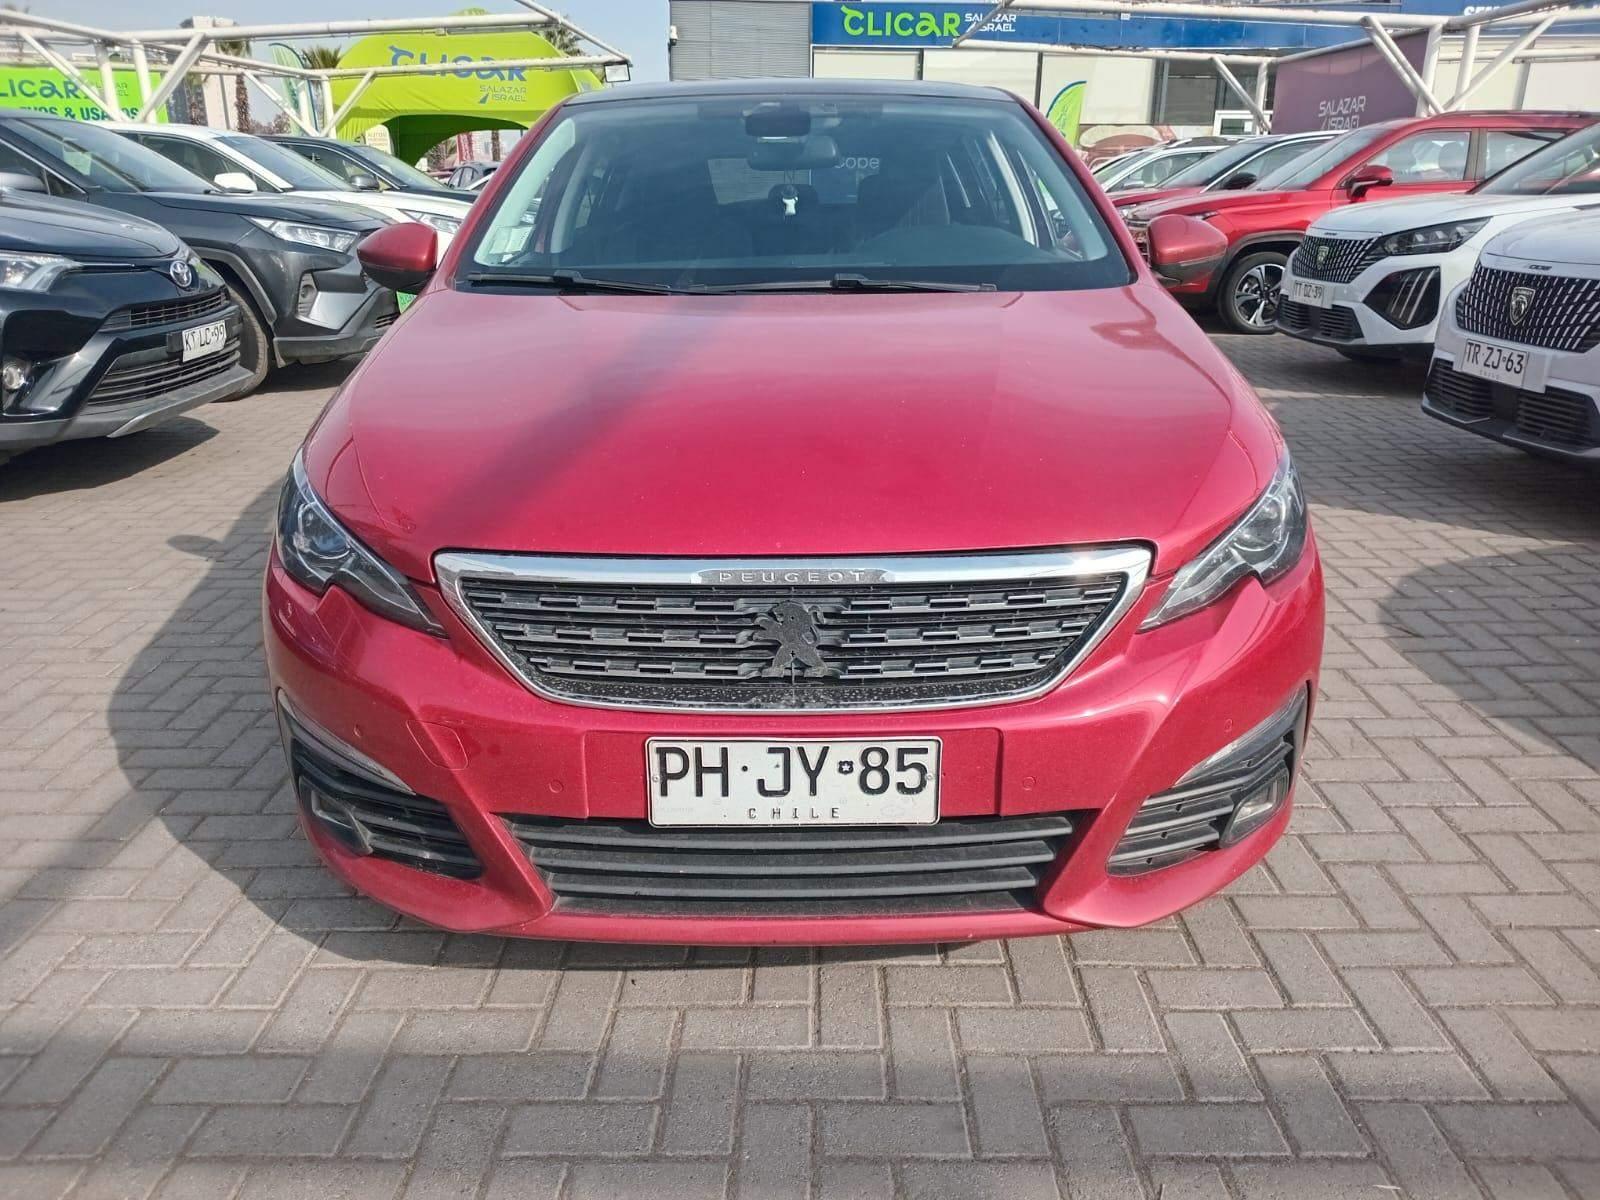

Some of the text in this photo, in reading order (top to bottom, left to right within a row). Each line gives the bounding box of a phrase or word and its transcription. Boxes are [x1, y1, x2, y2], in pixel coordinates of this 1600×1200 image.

[1318, 95, 1366, 117] SALAZAR
[719, 571, 865, 583] PEUGEOT
[748, 807, 840, 820] CHILE
